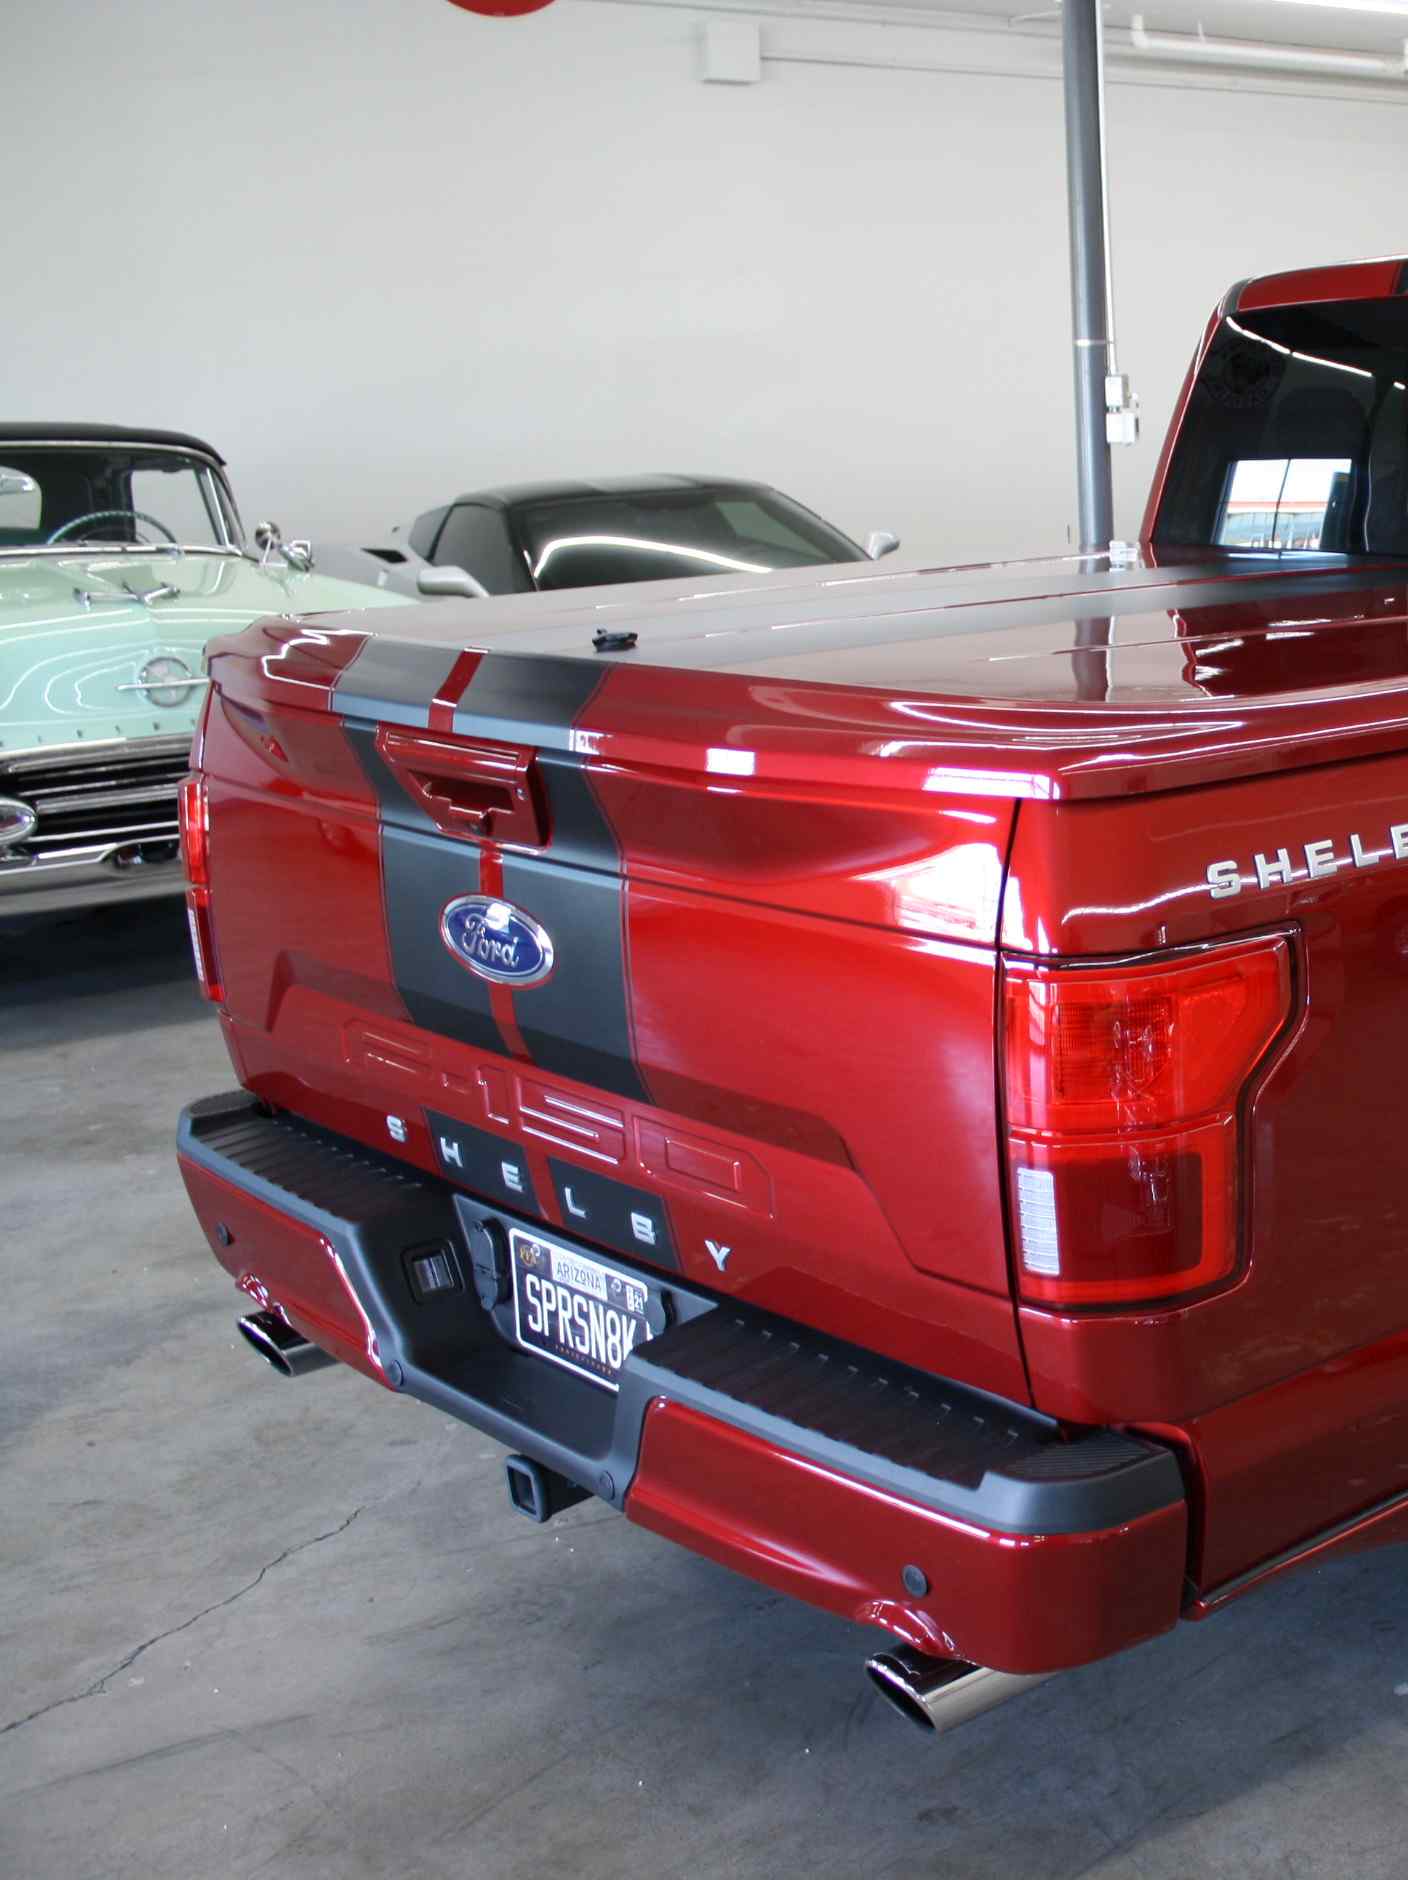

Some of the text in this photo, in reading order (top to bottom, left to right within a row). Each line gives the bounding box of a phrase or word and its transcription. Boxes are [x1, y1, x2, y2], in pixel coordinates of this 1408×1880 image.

[461, 912, 521, 968] Ford
[385, 1113, 733, 1272] SHELBY
[556, 1260, 602, 1291] ARIZONA
[525, 1273, 637, 1369] SPRSN8K
